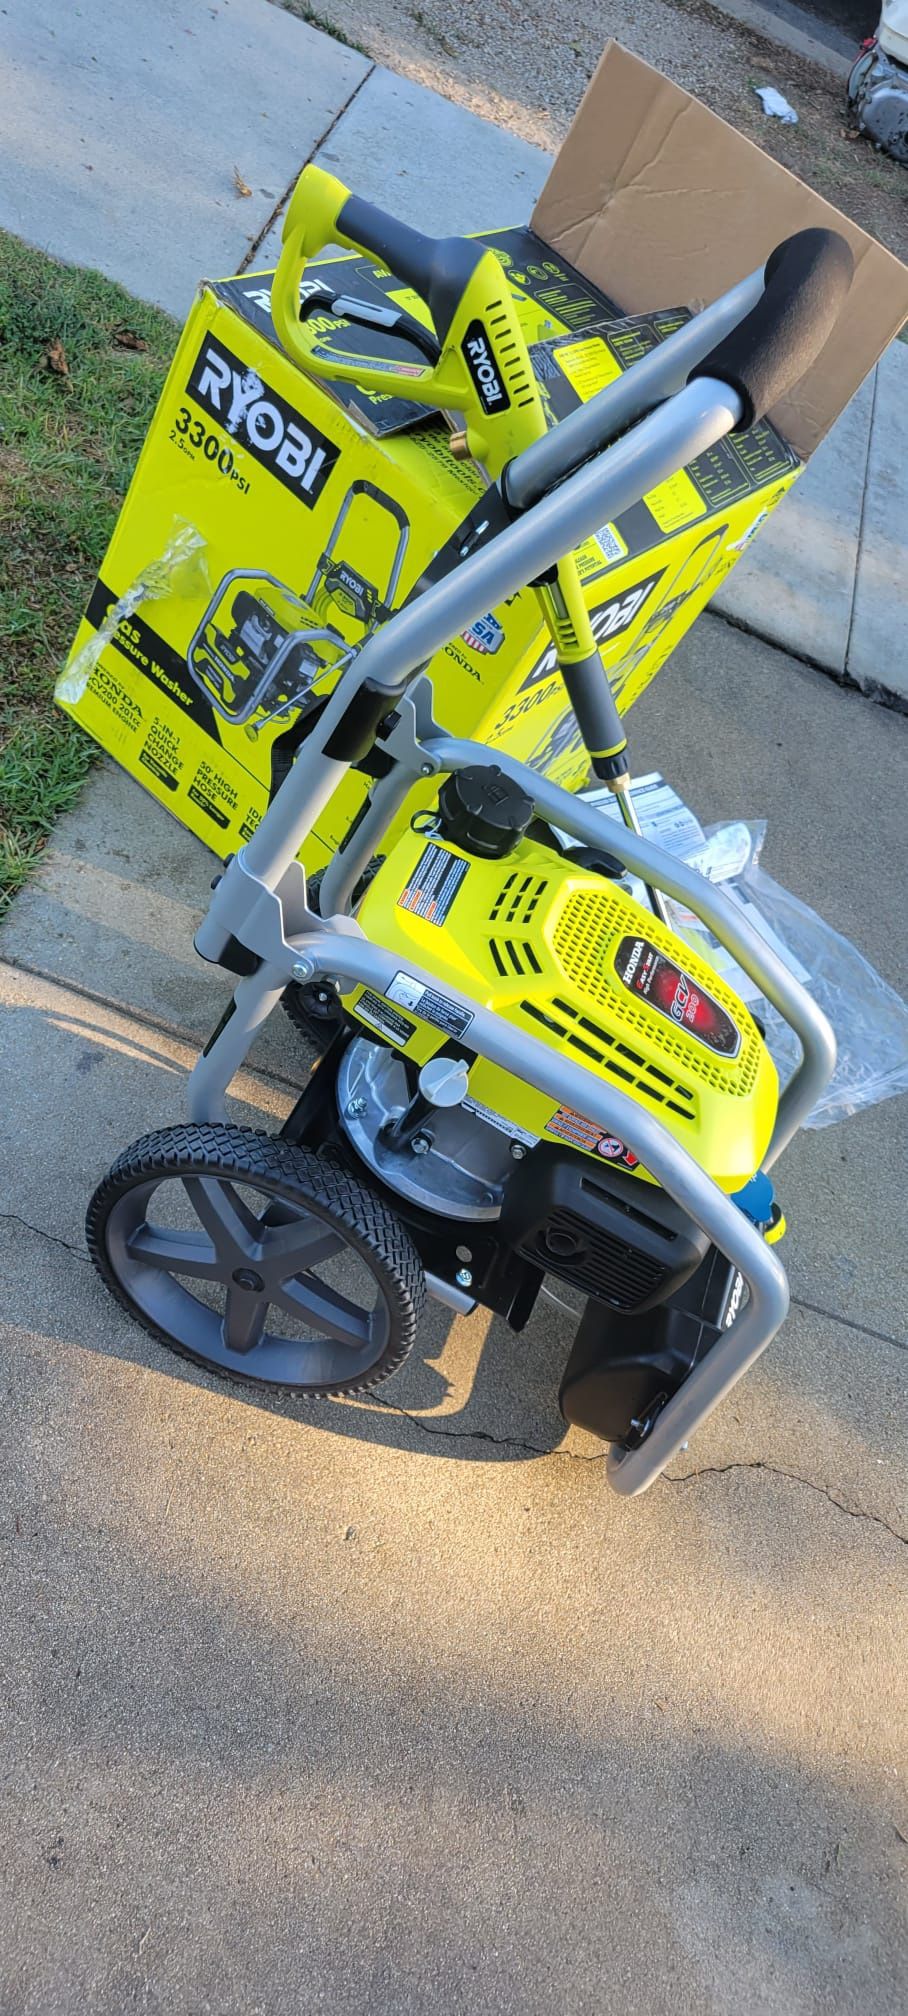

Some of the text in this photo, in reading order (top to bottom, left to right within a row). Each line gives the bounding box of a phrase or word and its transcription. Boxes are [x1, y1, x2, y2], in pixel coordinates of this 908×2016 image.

[467, 337, 503, 402] RYOBI
[197, 348, 327, 492] RYOBI
[339, 569, 365, 597] RYOBI
[471, 621, 495, 646] SA
[532, 581, 656, 679] ROBI
[113, 630, 193, 706] essure Washer
[443, 646, 481, 682] ONDA
[88, 676, 118, 705] CV200
[150, 725, 179, 754] QUICK
[153, 717, 181, 745] 5-IN-1
[144, 741, 178, 776] NOZZLE
[147, 733, 184, 770] CHANGE
[193, 777, 218, 802] HOSE
[197, 768, 238, 811] PRESSURE
[213, 773, 239, 799] HIGH
[623, 941, 645, 984] HONDA
[670, 973, 690, 1021] GCV
[685, 993, 699, 1023] 200
